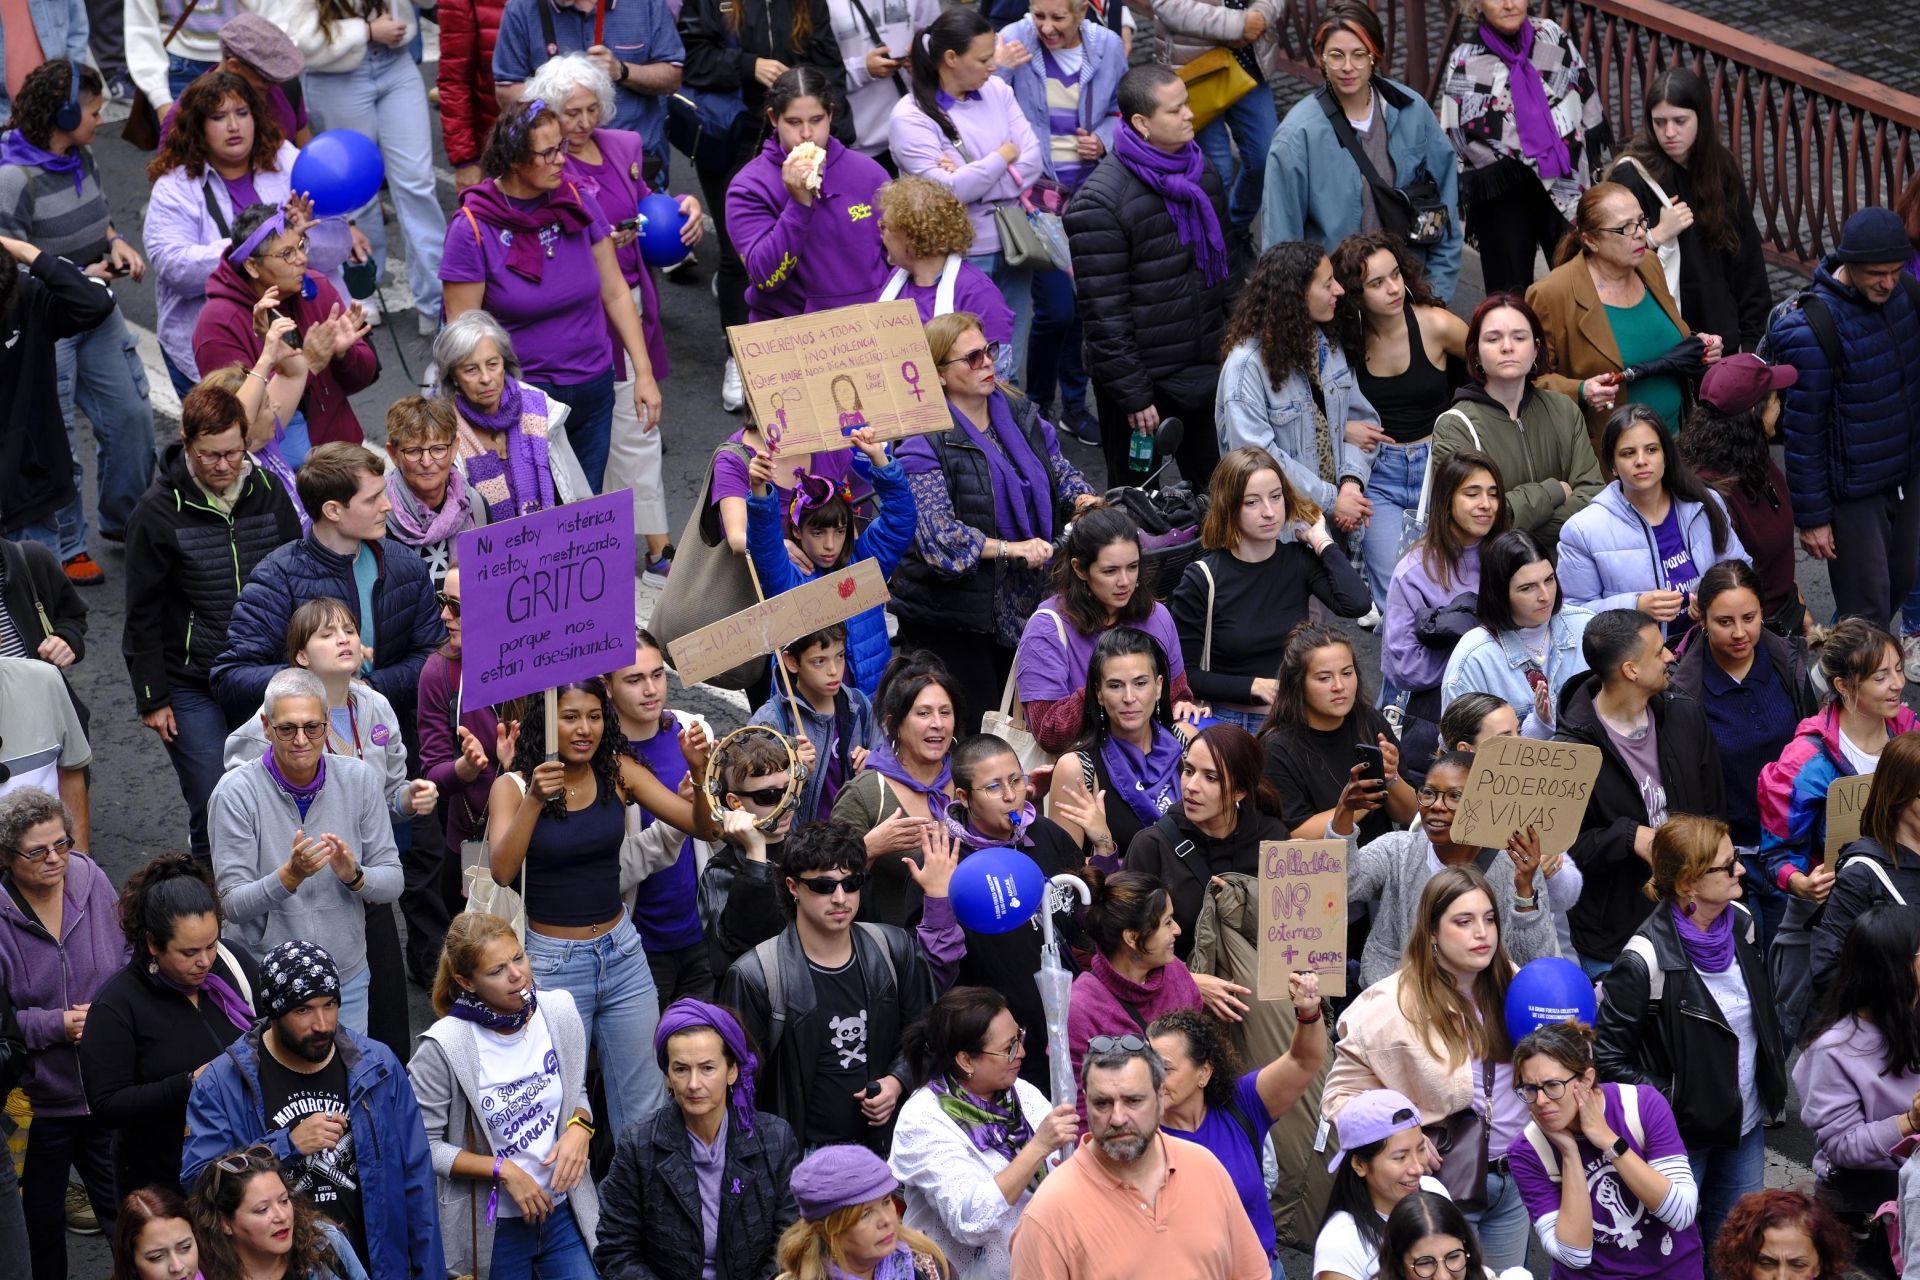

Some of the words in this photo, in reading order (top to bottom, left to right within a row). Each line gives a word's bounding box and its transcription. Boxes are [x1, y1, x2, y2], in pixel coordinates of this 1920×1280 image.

[819, 329, 828, 340] A
[829, 321, 863, 339] TODAS
[505, 524, 542, 549] estoy
[556, 509, 616, 534] histérica,
[491, 554, 528, 577] estoy
[539, 533, 621, 567] mestruando,
[506, 556, 606, 624] GRITO
[499, 629, 552, 658] porque
[565, 618, 595, 636] nos
[480, 658, 524, 684] están
[533, 632, 623, 669] asesinando.
[1476, 769, 1588, 801] PODEROSAS
[1268, 922, 1323, 942] estamos
[287, 1090, 339, 1100] AMERICAN
[503, 1101, 543, 1140] SOMOS
[314, 1192, 337, 1202] 1975
